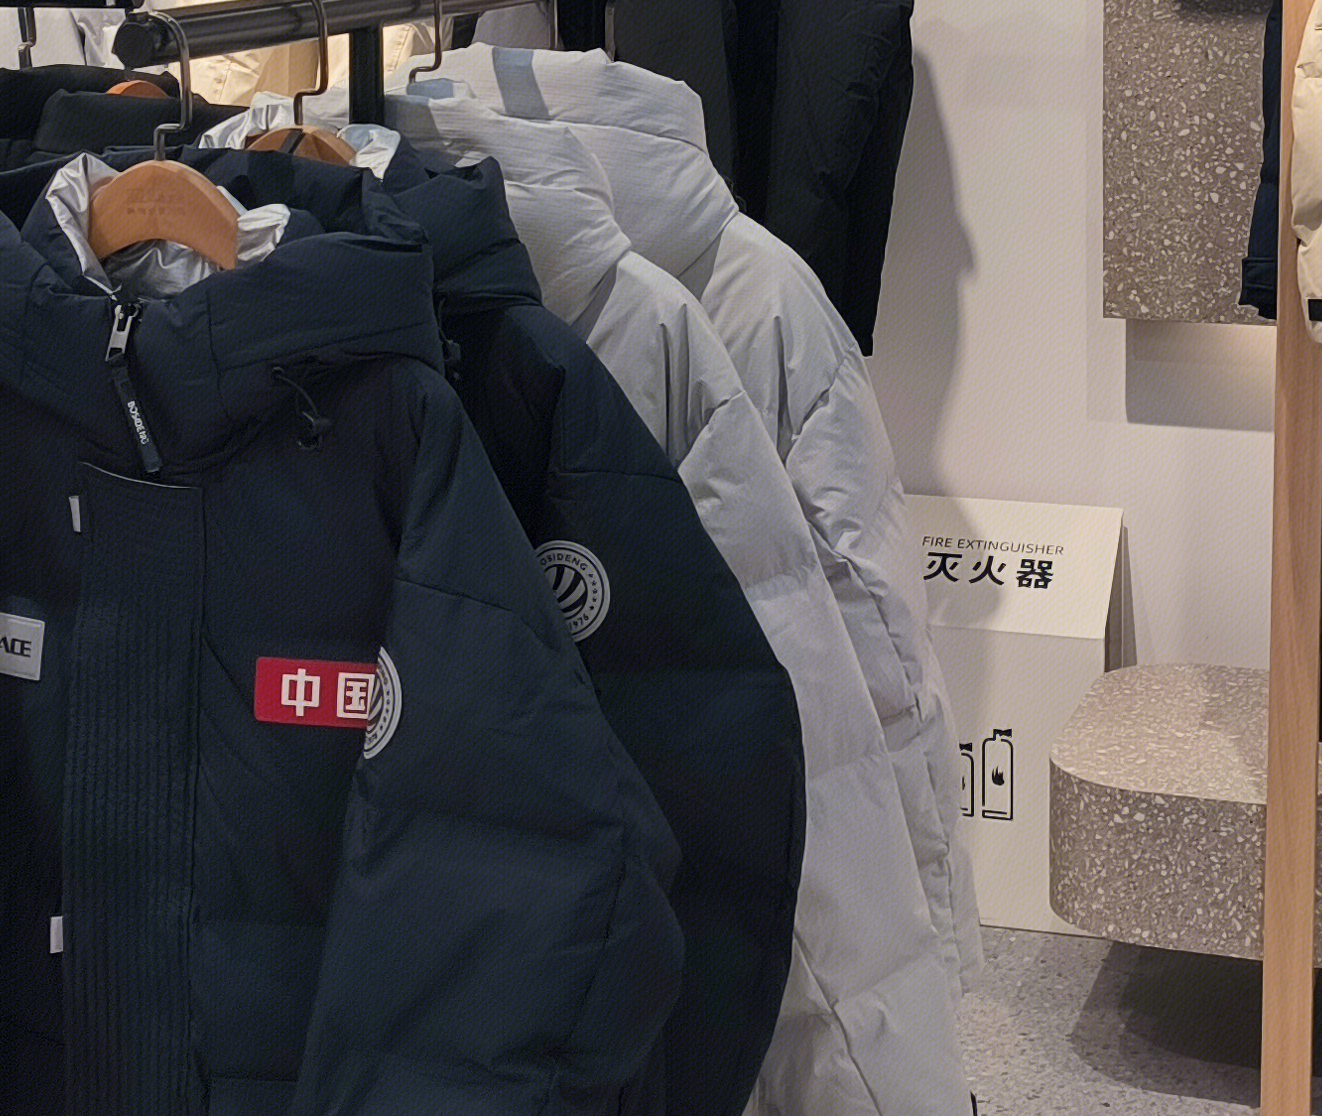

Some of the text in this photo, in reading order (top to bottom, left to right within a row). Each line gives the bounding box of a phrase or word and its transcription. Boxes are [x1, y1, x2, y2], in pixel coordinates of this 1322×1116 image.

[922, 535, 1064, 556] FIRE EXTINGUISHER
[923, 551, 1054, 590] 灭火器
[281, 668, 375, 720] 中国
